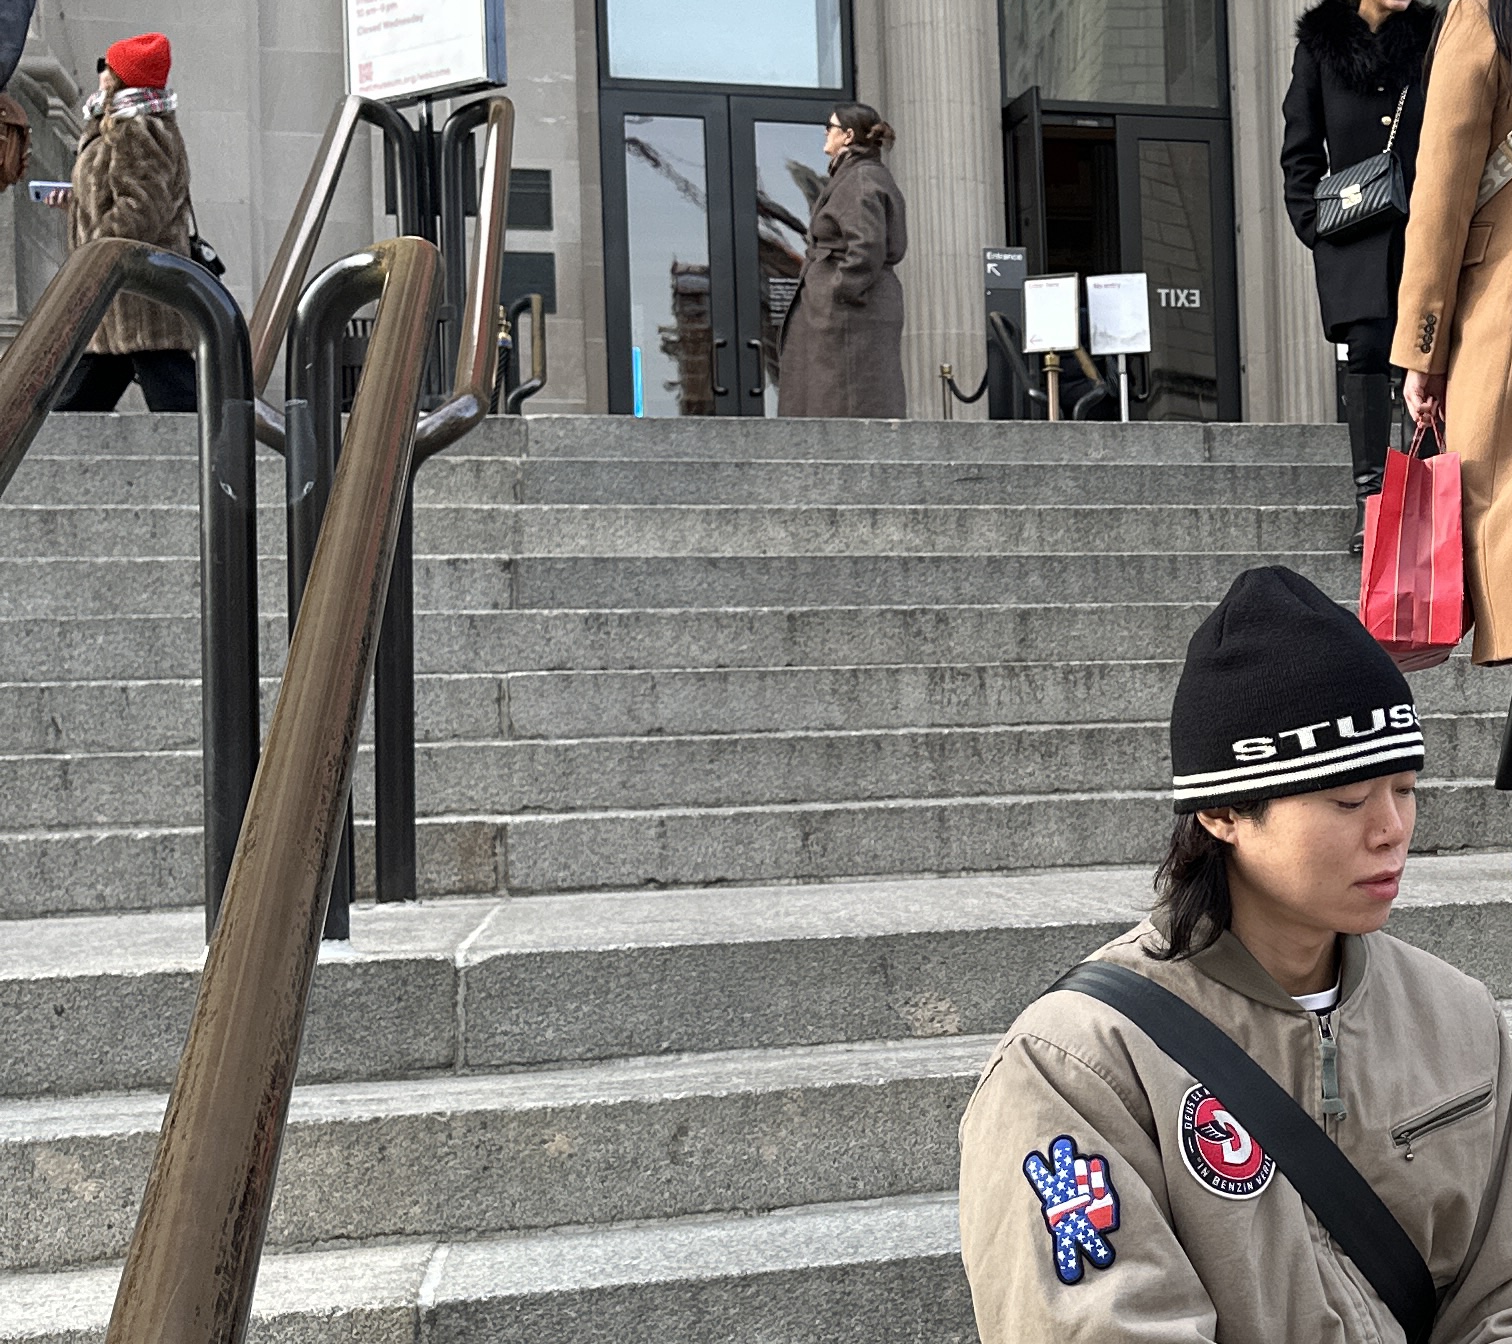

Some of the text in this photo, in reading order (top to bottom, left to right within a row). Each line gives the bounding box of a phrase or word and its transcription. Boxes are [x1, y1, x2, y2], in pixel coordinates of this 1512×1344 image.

[1232, 704, 1421, 761] STUS
[1184, 1100, 1196, 1130] DEUS
[1212, 1175, 1254, 1193] BENZIN
[1255, 1153, 1274, 1185] VERIT
